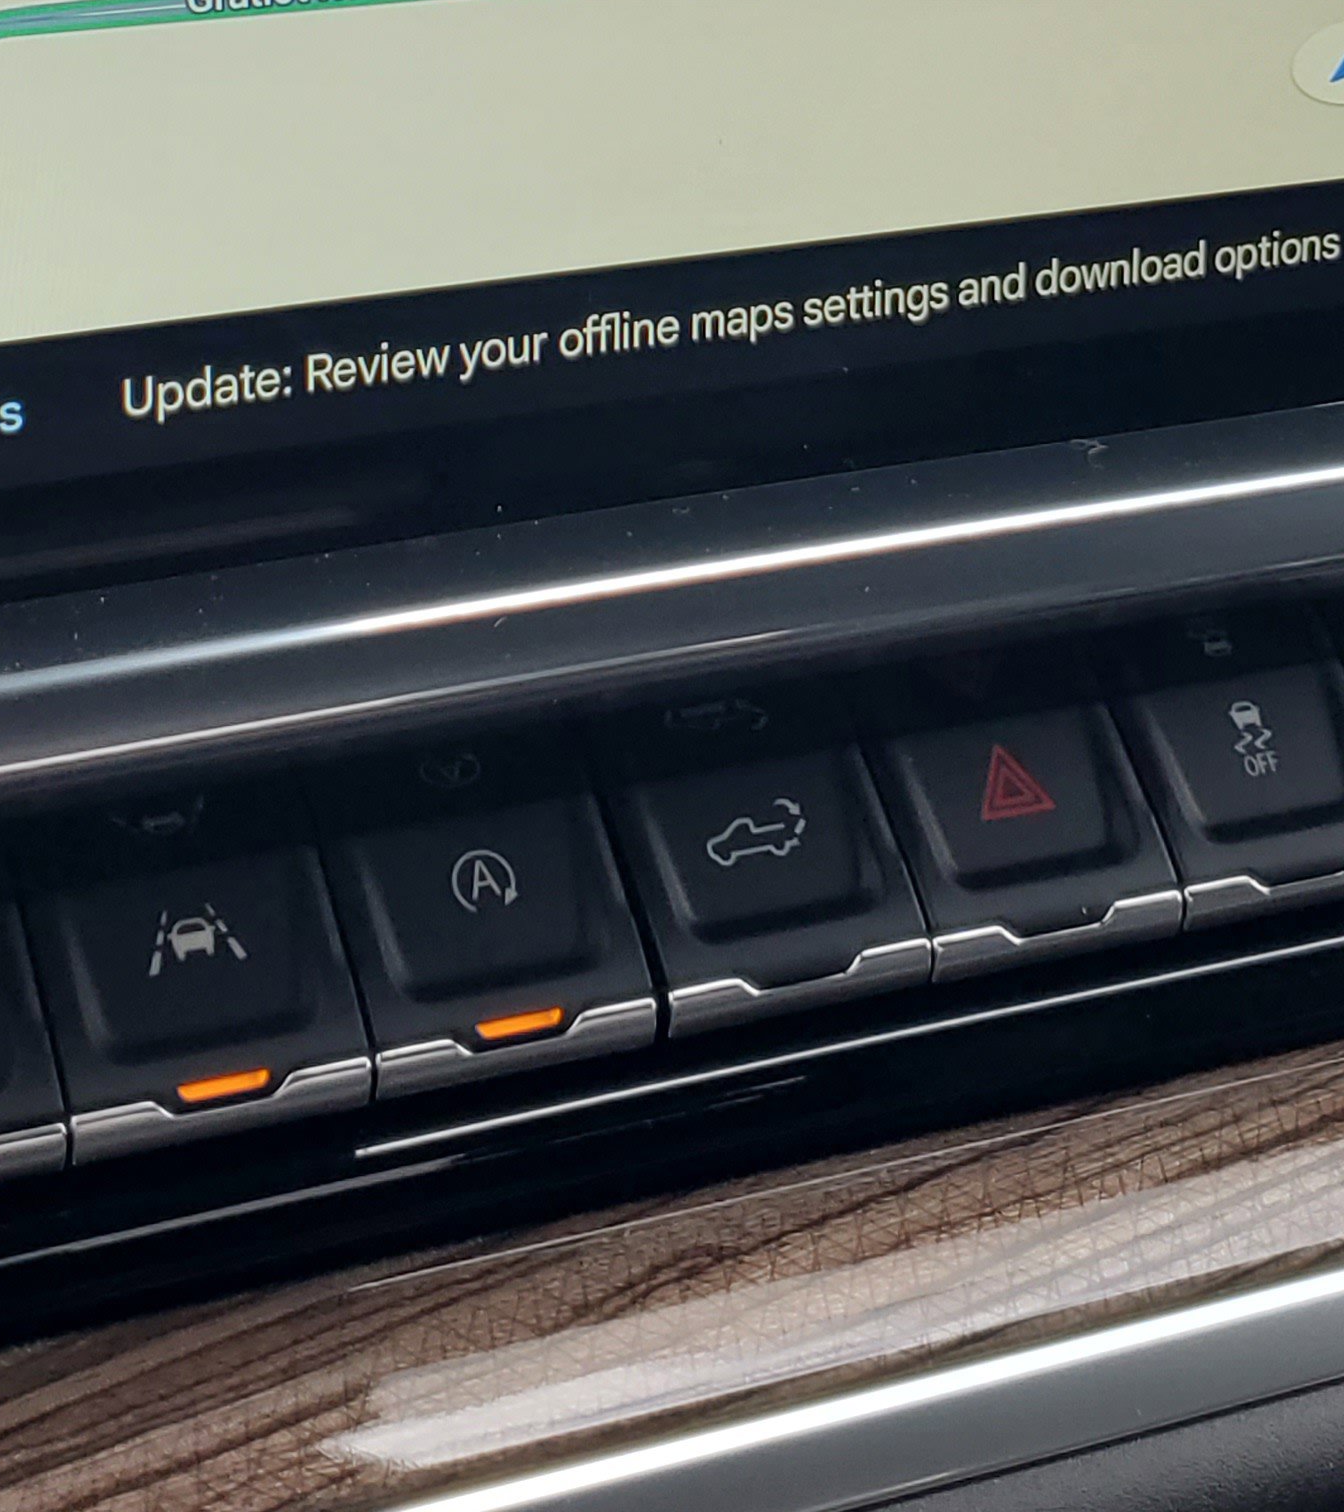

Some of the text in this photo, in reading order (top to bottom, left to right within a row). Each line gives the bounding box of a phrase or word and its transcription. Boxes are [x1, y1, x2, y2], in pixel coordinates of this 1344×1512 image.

[120, 225, 1342, 424] Update: Review your offline maps settings and download options
[1244, 750, 1278, 776] OFF
